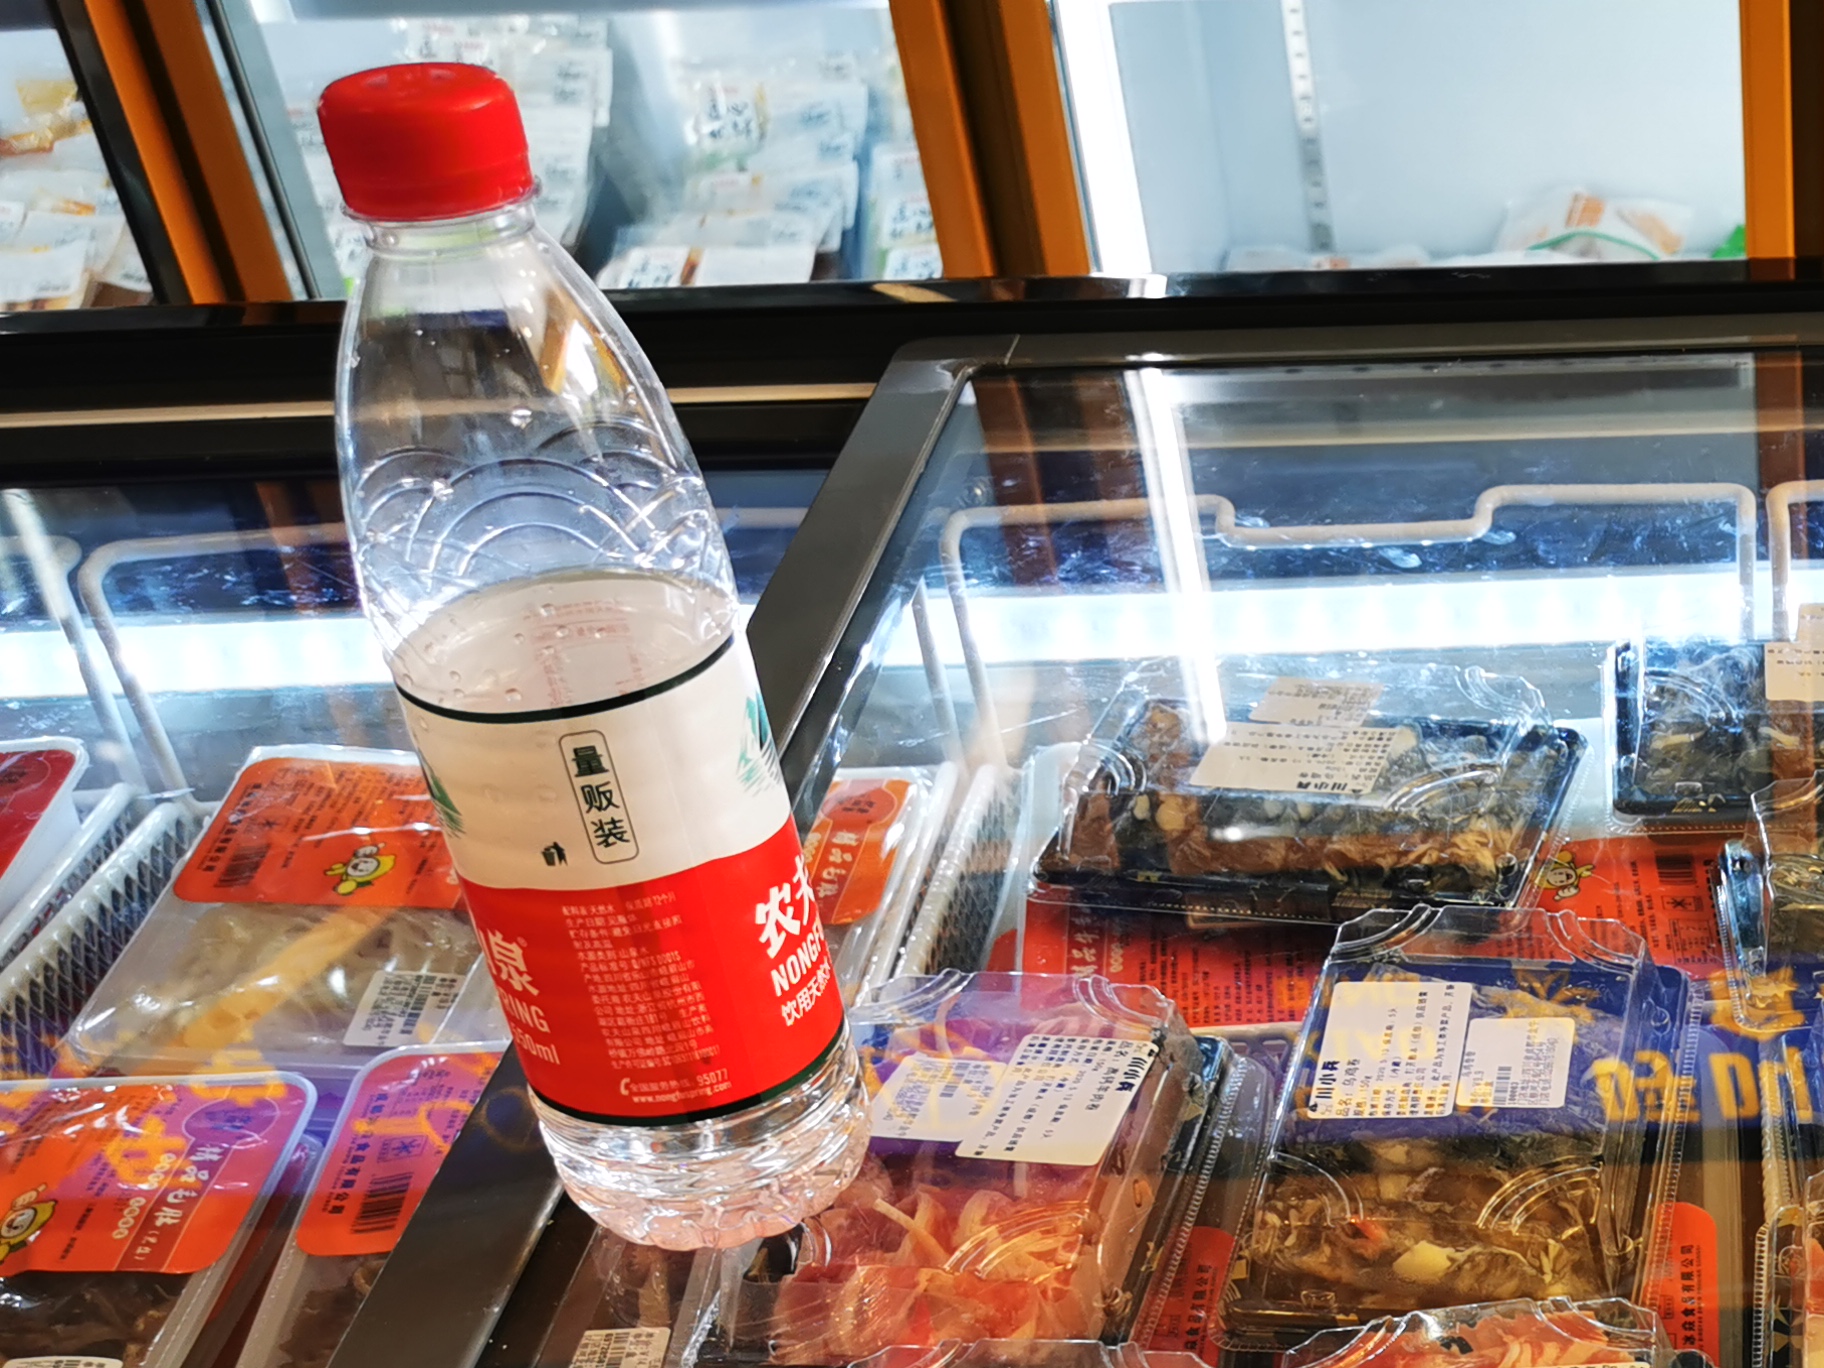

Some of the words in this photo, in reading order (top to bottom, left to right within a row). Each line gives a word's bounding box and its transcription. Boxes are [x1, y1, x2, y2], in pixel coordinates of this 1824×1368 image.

[570, 745, 632, 847] 量贩装
[481, 928, 540, 997] 泉
[696, 1067, 728, 1086] 95077
[1115, 1057, 1147, 1092] 川小兵
[1315, 1060, 1340, 1099] 川小兵
